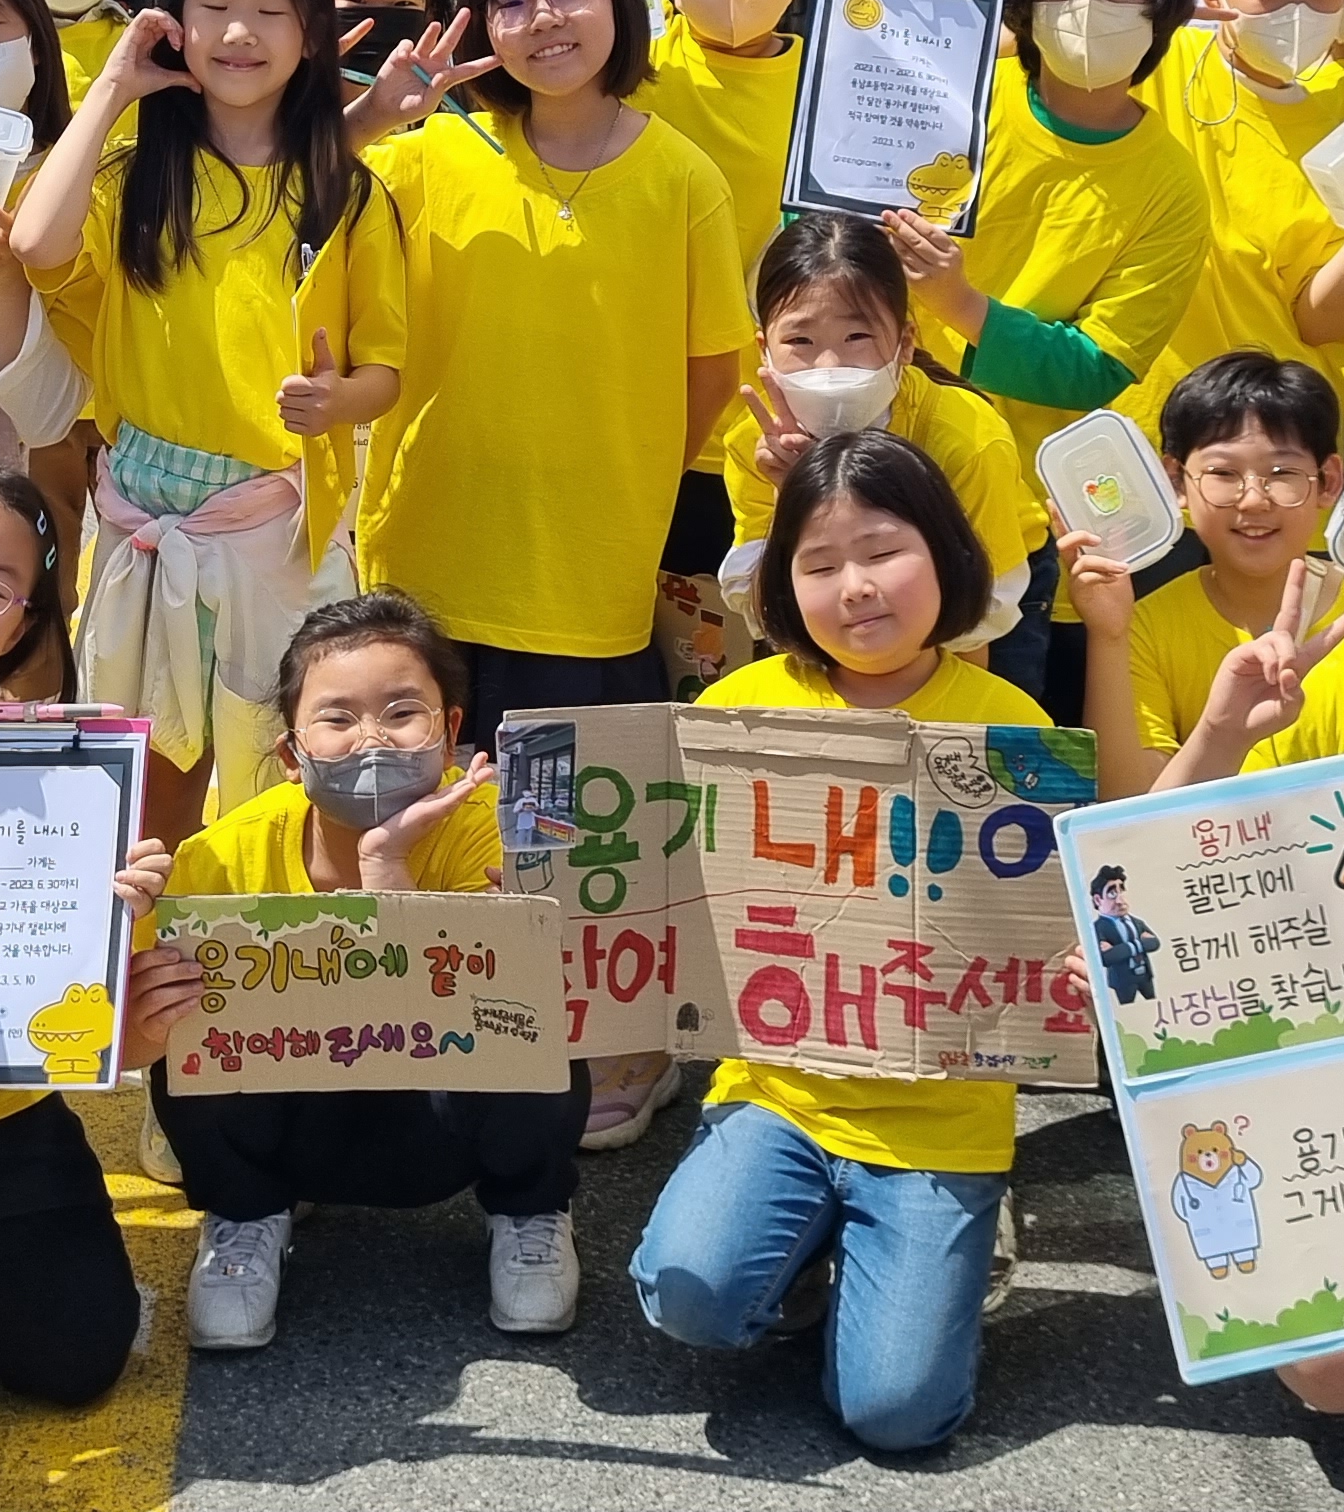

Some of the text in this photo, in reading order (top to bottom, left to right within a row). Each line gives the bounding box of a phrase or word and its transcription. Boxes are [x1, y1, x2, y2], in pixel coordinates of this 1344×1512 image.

[27, 856, 57, 871] 가게는
[1183, 862, 1296, 915] 챌린지에
[1170, 903, 1333, 974] 함께 해주실
[423, 940, 496, 997] 같이
[1154, 975, 1265, 1028] 사장님을
